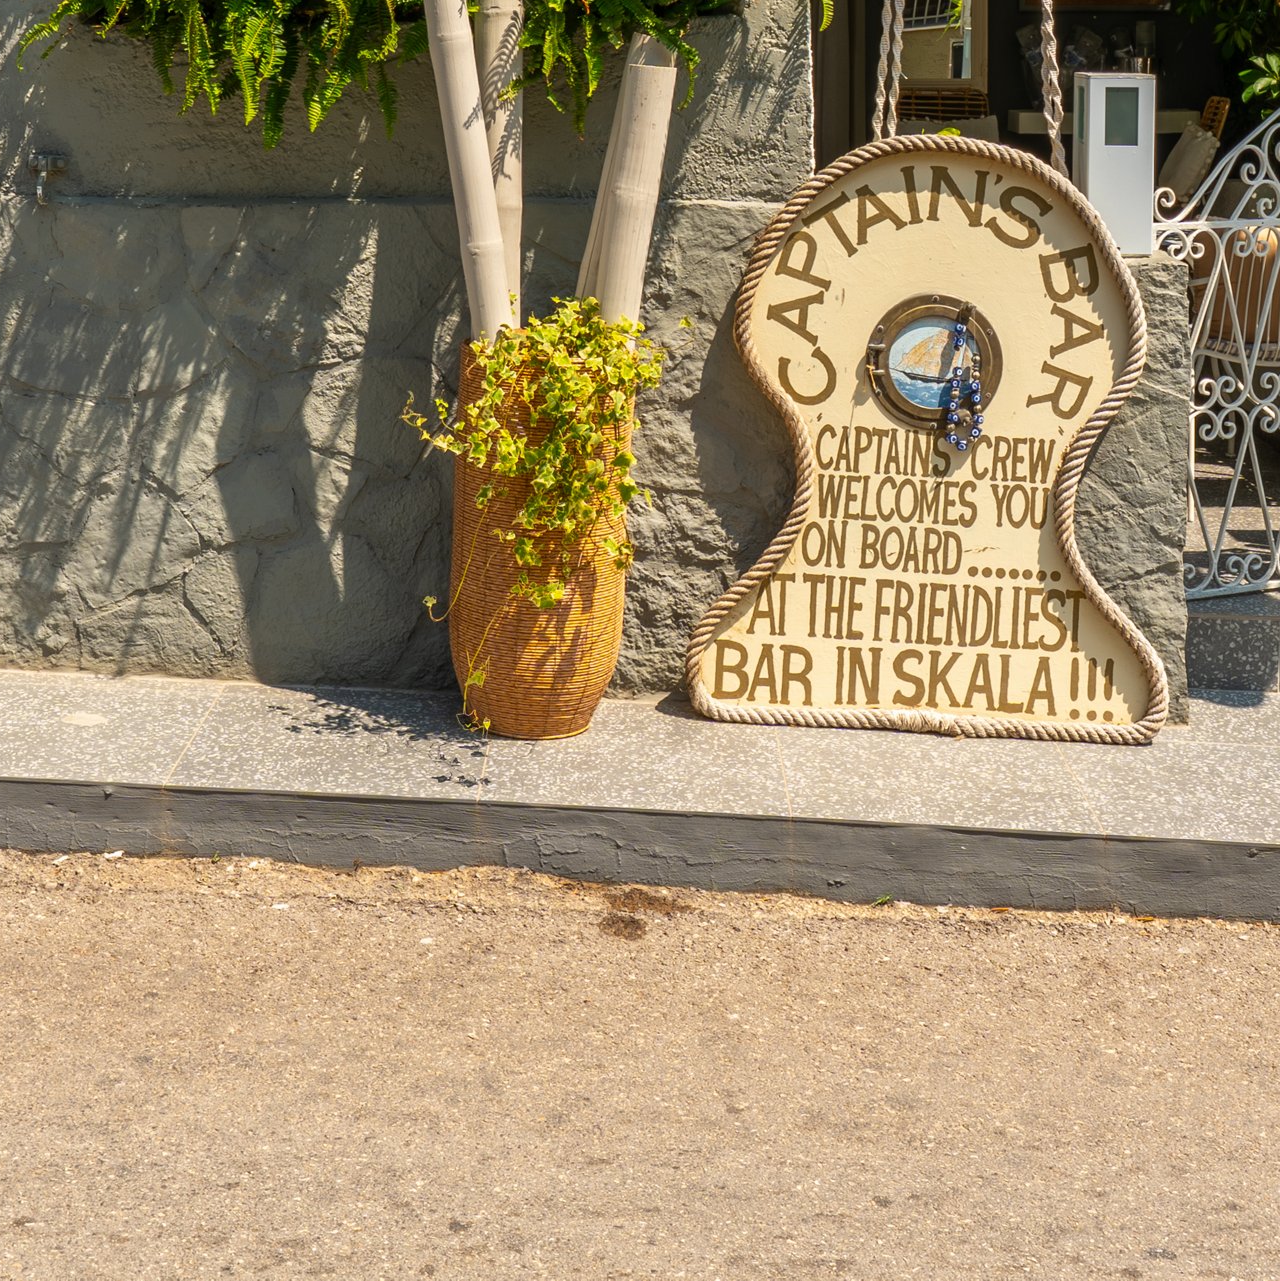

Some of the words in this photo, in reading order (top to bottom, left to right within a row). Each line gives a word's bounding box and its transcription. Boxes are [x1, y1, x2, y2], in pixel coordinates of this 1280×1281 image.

[767, 165, 1054, 407] CAPTAIN'S
[1025, 242, 1105, 421] BAR
[817, 473, 978, 528] WELCOMES
[989, 483, 1052, 530] YOU
[801, 519, 849, 569] ON
[745, 571, 796, 636] AT
[802, 572, 867, 642] THE
[872, 577, 1087, 653] FRIENDLIEST
[710, 638, 814, 706] BAR
[833, 645, 882, 706] IN
